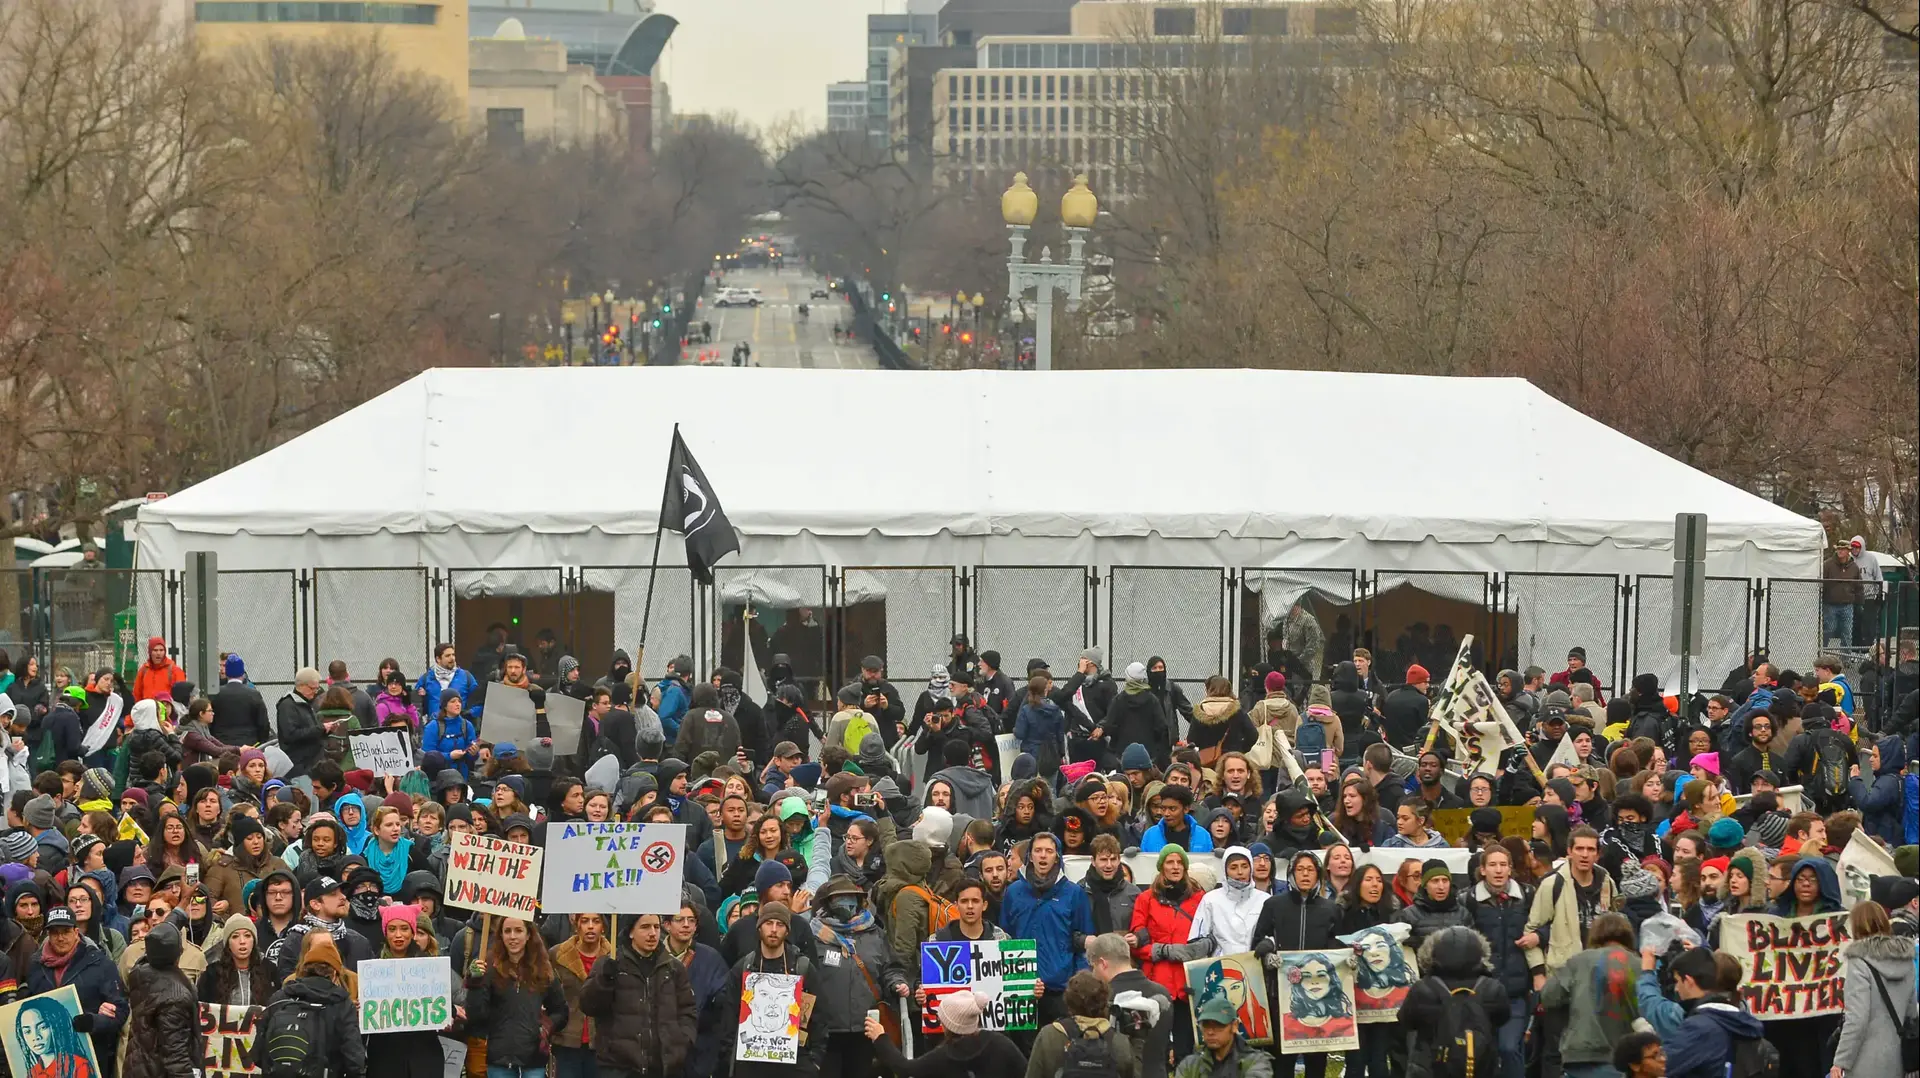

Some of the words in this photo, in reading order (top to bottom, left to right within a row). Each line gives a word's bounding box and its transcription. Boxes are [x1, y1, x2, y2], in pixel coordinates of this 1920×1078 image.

[460, 834, 538, 856] SOLIDARITY
[562, 823, 646, 839] ALT-RIGHT
[595, 836, 640, 851] TAKE
[453, 850, 496, 874] WITH
[498, 857, 532, 879] THE
[606, 853, 620, 868] A
[572, 869, 643, 892] HIKE!!!
[1745, 914, 1852, 952] BLACK
[970, 944, 1036, 981] también
[1750, 948, 1841, 984] LIVES
[1739, 977, 1845, 1015] MATTER
[198, 1003, 263, 1035] BLA
[363, 995, 448, 1031] RACISTS
[202, 1036, 257, 1072] LIV
[769, 1036, 791, 1046] NOT
